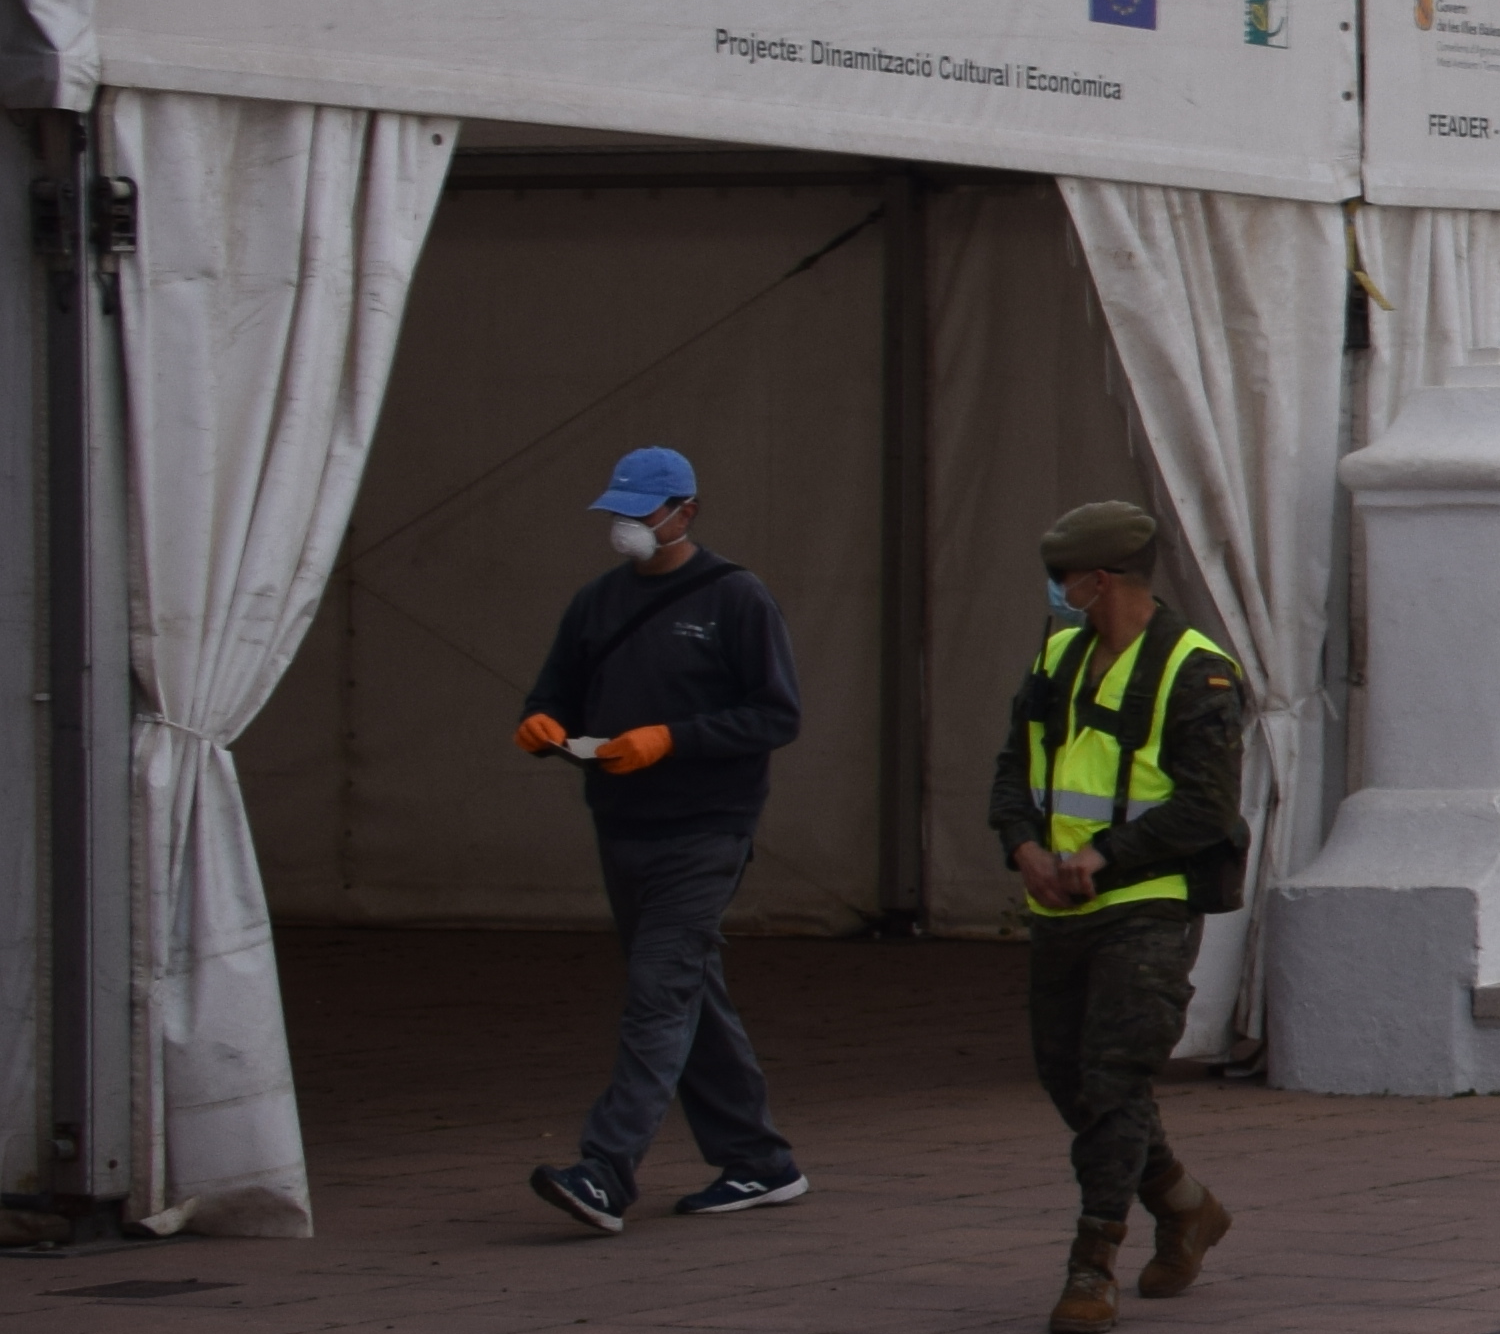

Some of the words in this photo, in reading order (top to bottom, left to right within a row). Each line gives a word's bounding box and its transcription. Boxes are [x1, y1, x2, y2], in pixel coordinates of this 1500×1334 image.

[715, 28, 803, 64] Projecte:
[811, 39, 932, 78] Dinamització
[939, 55, 1009, 87] Cultural
[1026, 66, 1122, 101] Econòmica
[1428, 114, 1490, 139] FEADER
